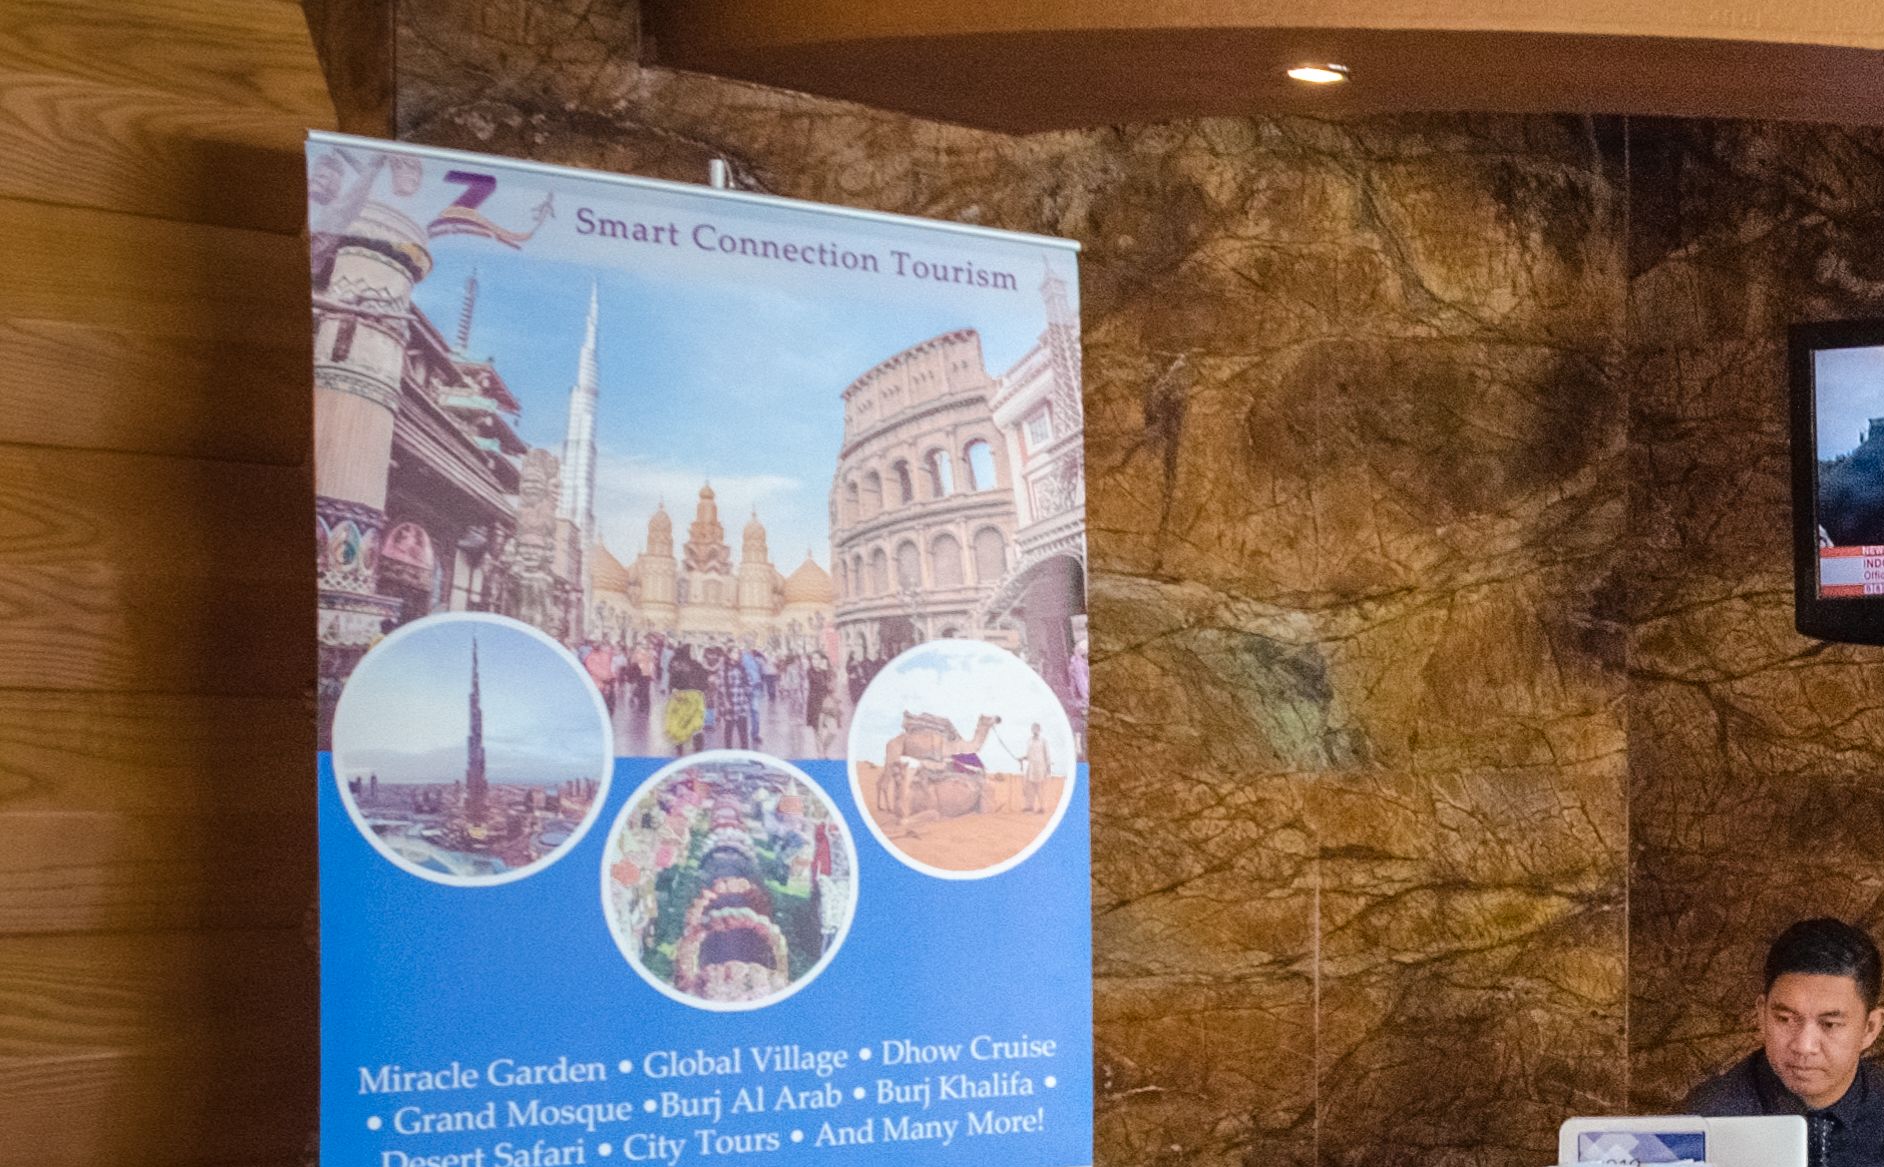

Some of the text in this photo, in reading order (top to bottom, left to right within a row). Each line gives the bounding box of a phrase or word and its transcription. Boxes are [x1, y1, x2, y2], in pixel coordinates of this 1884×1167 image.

[576, 207, 1019, 291] Smart Connection Tourism
[358, 1033, 1057, 1095] Miracle Garden Global Village Dhow Cruise
[393, 1071, 1034, 1136] Grand Mosque Burj Al Arab Burj Khalifa
[623, 1132, 686, 1167] City
[694, 1128, 780, 1156] Tours
[814, 1119, 874, 1148] And
[882, 1115, 958, 1146] Many
[967, 1107, 1045, 1137] More!
